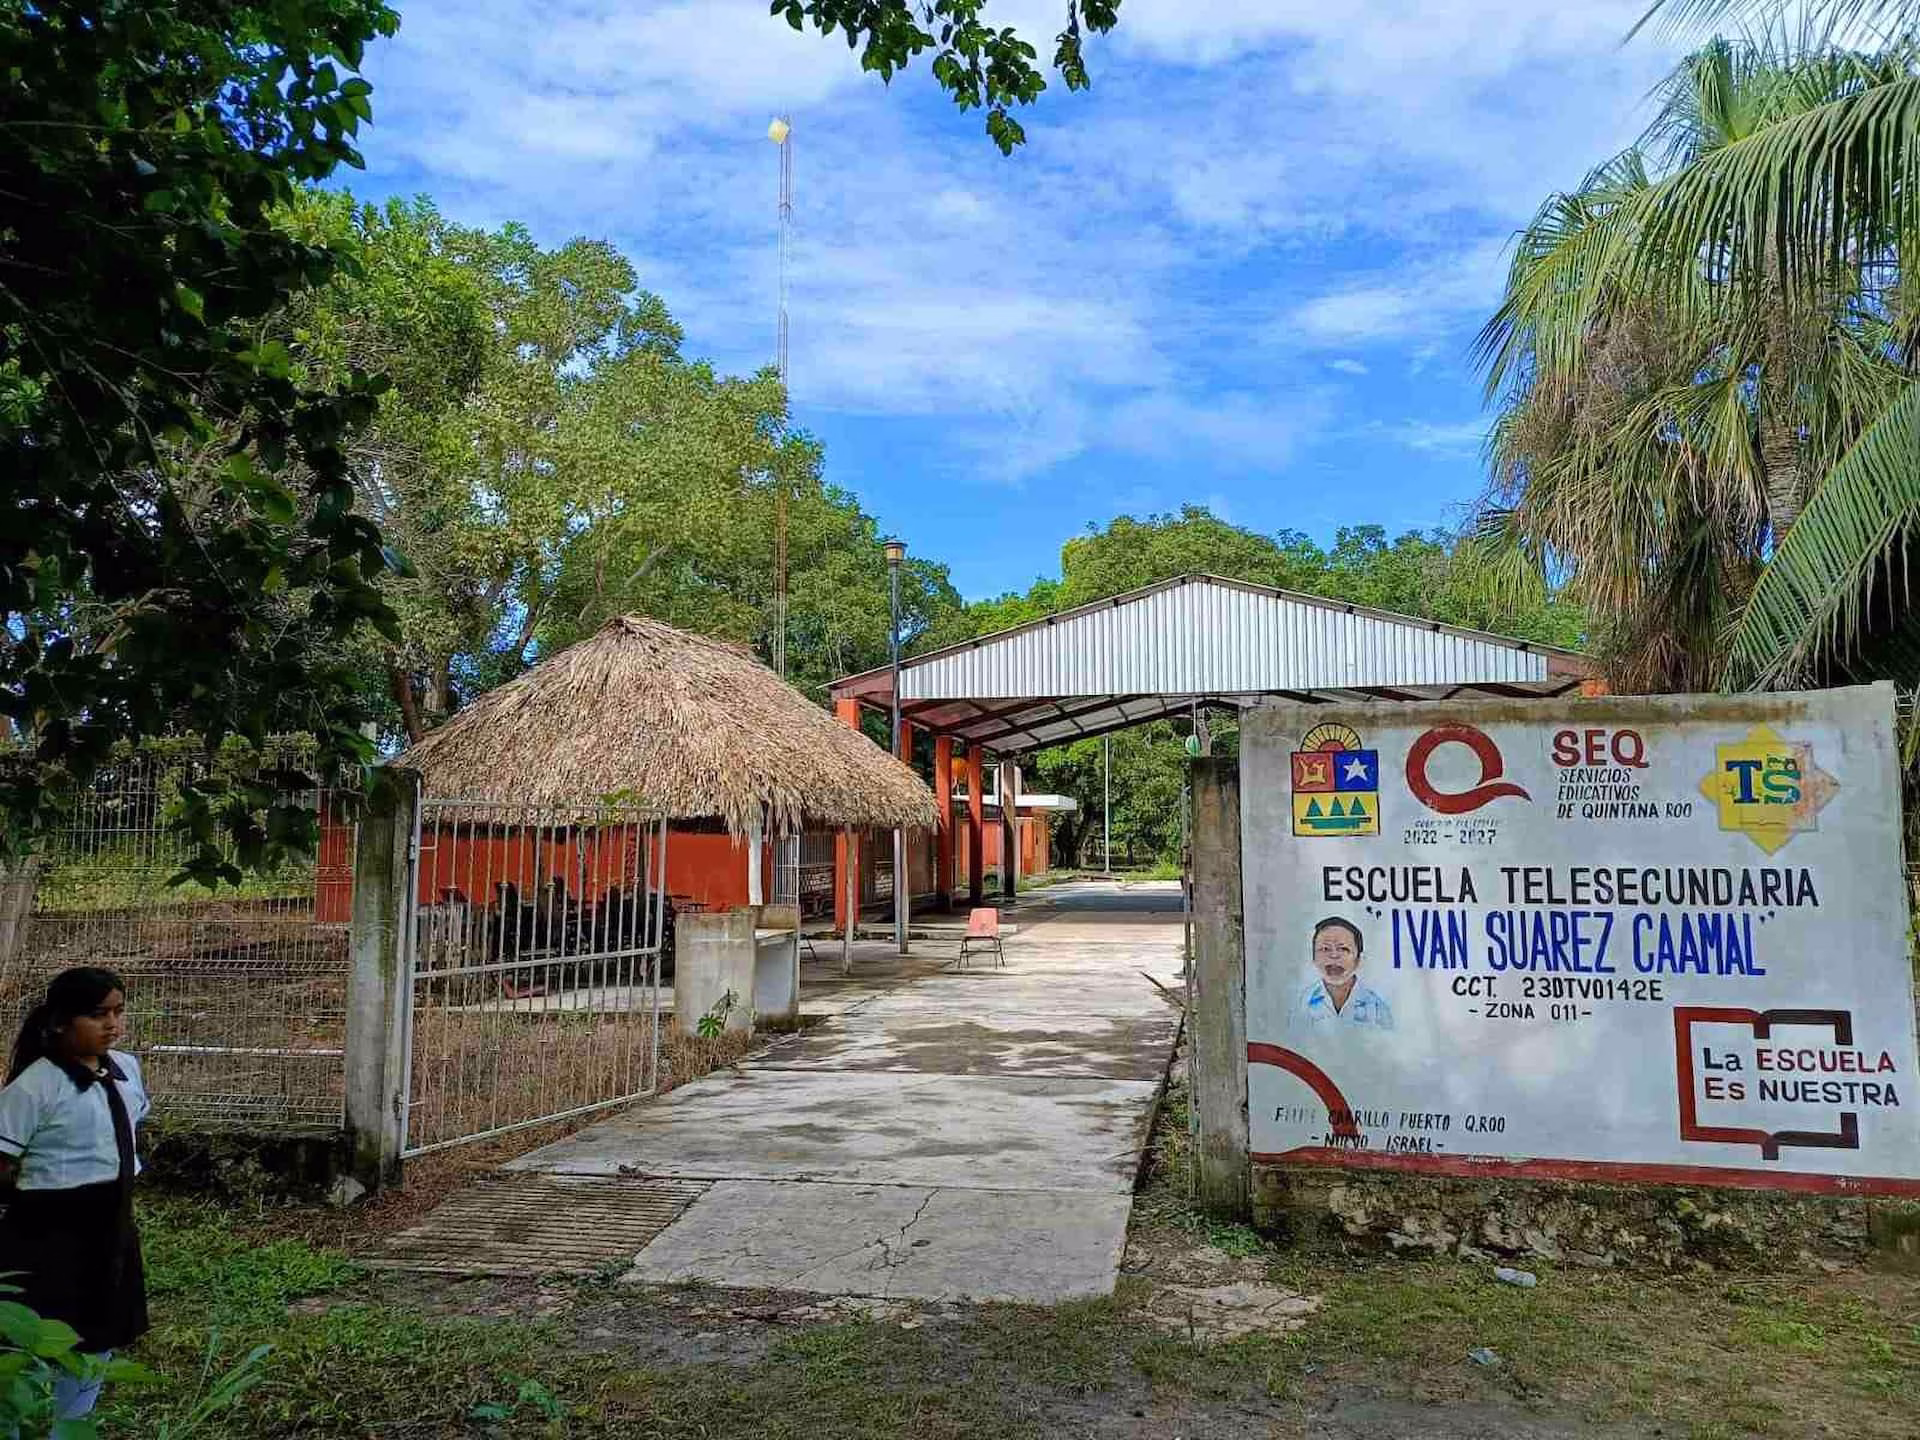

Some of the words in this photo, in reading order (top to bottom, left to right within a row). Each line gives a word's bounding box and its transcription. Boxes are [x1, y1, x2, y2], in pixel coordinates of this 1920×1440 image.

[1551, 729, 1649, 768] SEQ
[1559, 768, 1632, 784] SERVICIOS
[1558, 785, 1640, 801] EDUCATIVOS
[1557, 803, 1575, 819] DE
[1582, 803, 1659, 819] QUINTANA
[1665, 803, 1692, 818] ROO
[1403, 829, 1437, 845] 2022
[1323, 867, 1478, 903] ESCUELA
[1501, 867, 1819, 907] TELESECUNDARIA
[1485, 911, 1615, 973] SUAREZ
[1452, 976, 1497, 998] CCT.
[1522, 977, 1664, 1001] 23DTV0142E
[1703, 1047, 1743, 1071] La
[1757, 1048, 1897, 1073] ESCUELA
[1704, 1077, 1745, 1100] Es
[1758, 1080, 1900, 1106] NUESTRA
[1400, 1113, 1450, 1131] PUERTO
